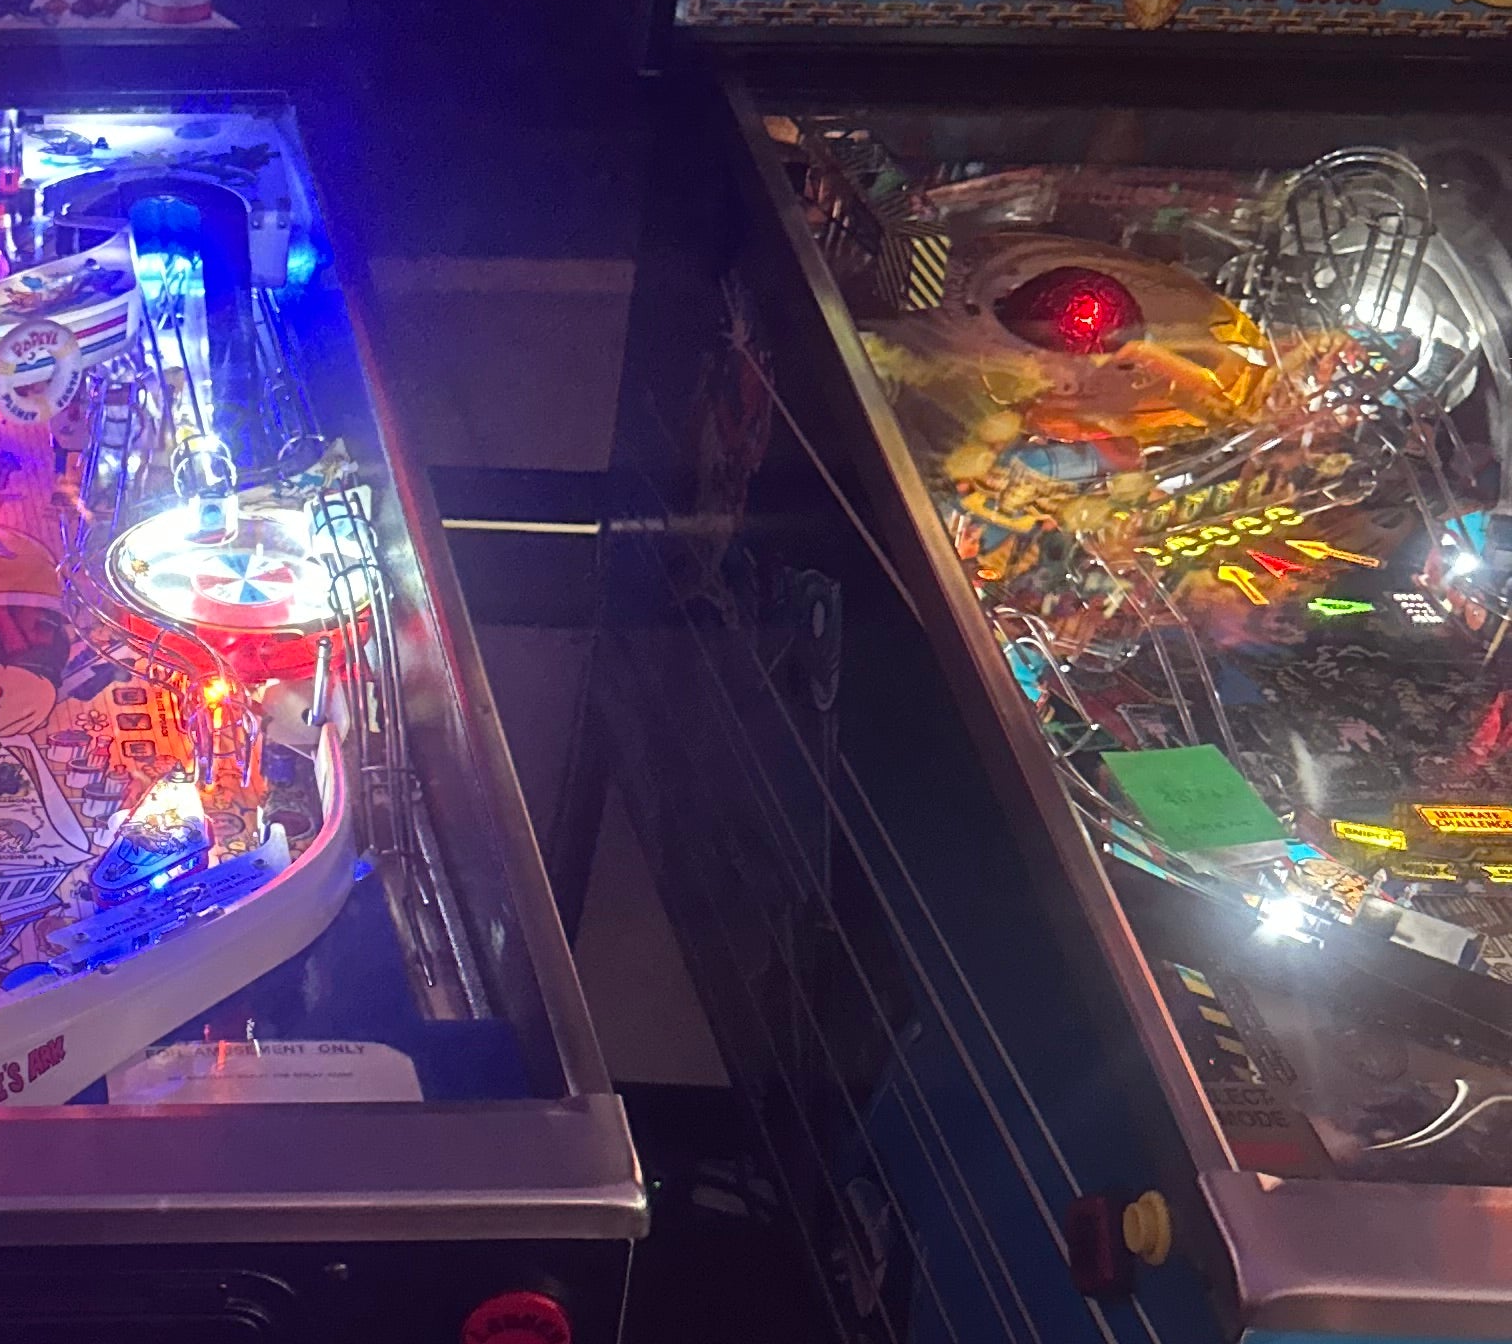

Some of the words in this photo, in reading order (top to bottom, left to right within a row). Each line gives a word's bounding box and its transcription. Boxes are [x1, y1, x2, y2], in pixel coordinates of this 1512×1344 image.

[1433, 810, 1500, 820] ULTIMATE
[318, 1043, 366, 1055] ONLY
[27, 1035, 67, 1083] ARK
